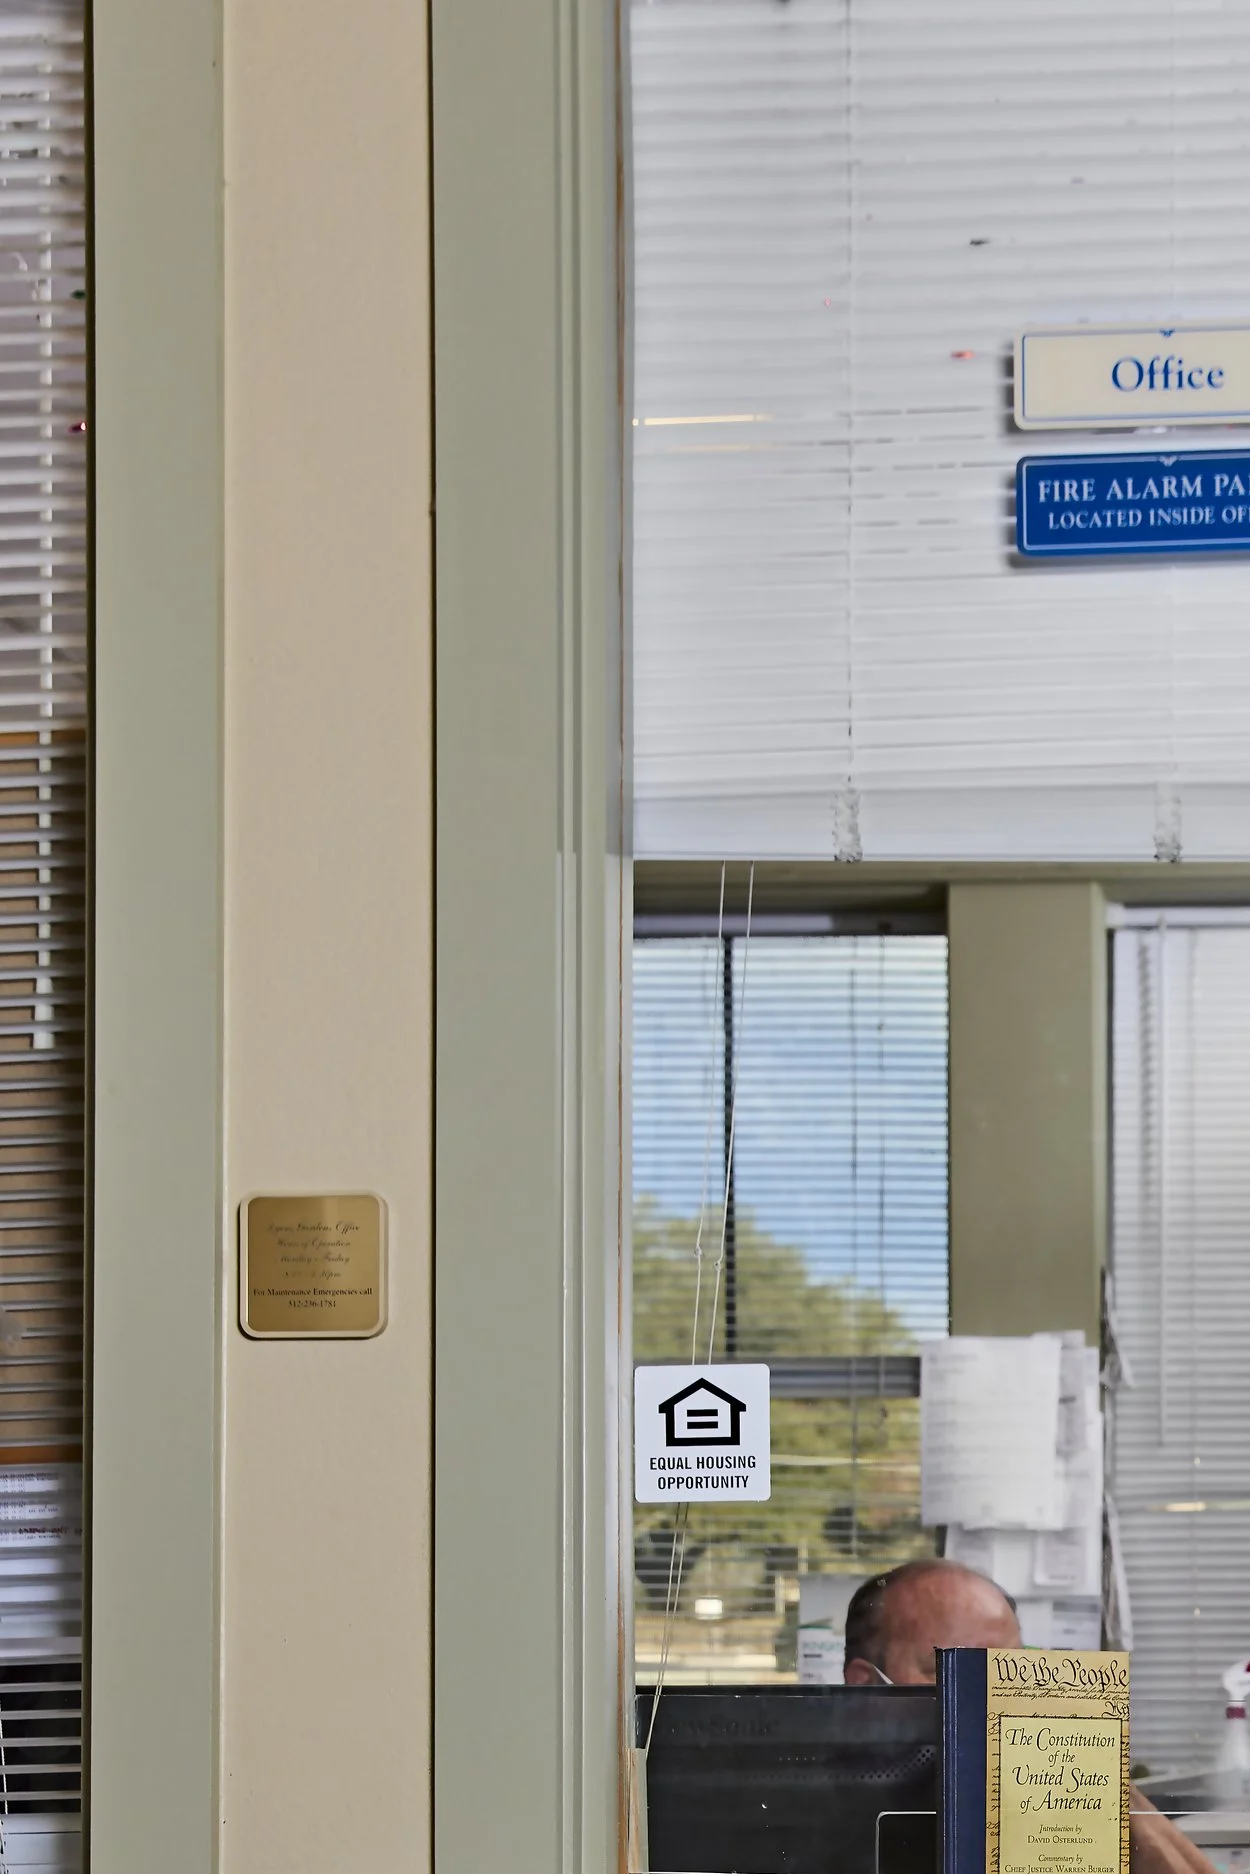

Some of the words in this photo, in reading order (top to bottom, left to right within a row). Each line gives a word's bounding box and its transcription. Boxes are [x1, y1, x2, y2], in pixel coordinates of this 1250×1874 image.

[1111, 354, 1225, 392] Office
[1038, 478, 1097, 503] FIRE
[1106, 474, 1203, 501] ALARM
[1048, 508, 1142, 530] LOCATED
[1149, 506, 1216, 527] INSIDE
[267, 1287, 311, 1296] Maintenance
[313, 1287, 358, 1297] Emergencies
[359, 1287, 373, 1296] call
[649, 1457, 693, 1471] EQUAL
[696, 1455, 756, 1469] HOUSING
[657, 1475, 749, 1490] OPPORTUNITY
[992, 1653, 1032, 1686] We
[1031, 1656, 1063, 1688] the
[1061, 1657, 1129, 1694] People
[1005, 1728, 1033, 1746] The
[1036, 1727, 1115, 1751] Constitution
[1048, 1750, 1060, 1767] of
[1061, 1749, 1076, 1763] the
[1012, 1764, 1064, 1786] United
[1066, 1767, 1109, 1793] States
[1020, 1796, 1032, 1814] of
[1032, 1789, 1102, 1812] America
[1039, 1824, 1074, 1834] Introduction
[1075, 1823, 1083, 1835] by
[1027, 1835, 1051, 1844] DAVID
[1038, 1854, 1075, 1865] Commentary
[1075, 1854, 1083, 1864] by
[1004, 1864, 1026, 1873] CHIEF
[1027, 1864, 1054, 1874] JUSTICE
[1055, 1864, 1086, 1873] WARREN
[1088, 1864, 1115, 1873] BURGER
